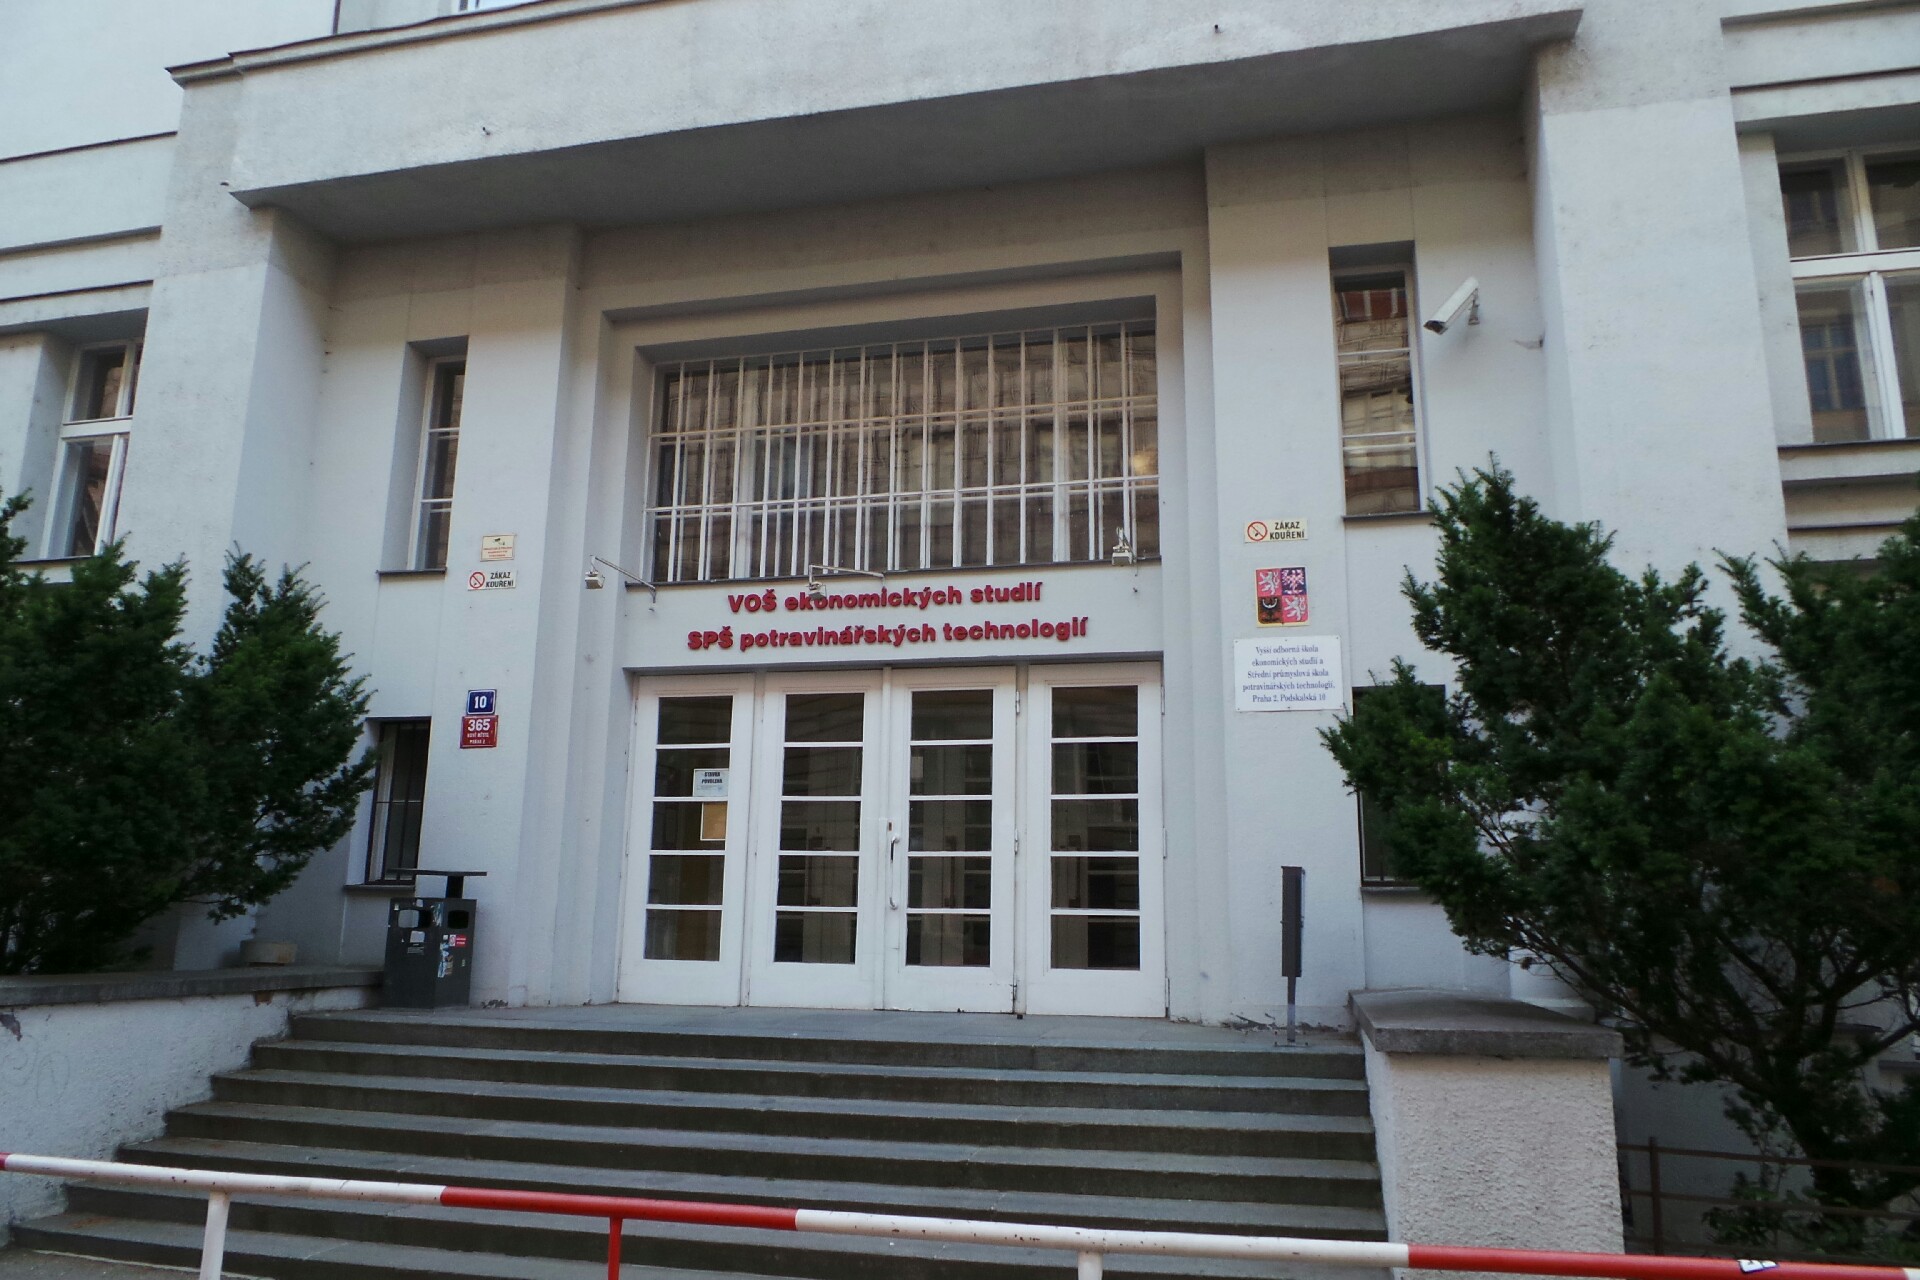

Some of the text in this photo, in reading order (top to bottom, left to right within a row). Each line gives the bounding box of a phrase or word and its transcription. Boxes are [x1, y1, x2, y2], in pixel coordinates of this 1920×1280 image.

[1274, 520, 1300, 530] ZÁKAZ
[1269, 529, 1305, 540] KOUŘENÍ
[490, 570, 511, 580] ZÁKAZ
[727, 581, 1043, 613] VOŠ ekonomických studií
[687, 616, 1089, 652] SPŠ potravinářských technologií
[1272, 645, 1300, 654] odborná
[1301, 644, 1319, 653] škola
[1251, 657, 1298, 667] ekonomických
[1299, 656, 1318, 665] studií
[1247, 668, 1329, 679] Střední průmyslová škola
[1242, 681, 1295, 692] potravinářských
[474, 695, 487, 709] 10
[1252, 694, 1272, 703] Praha
[1280, 693, 1317, 702] Podskalská
[467, 718, 491, 732] 365
